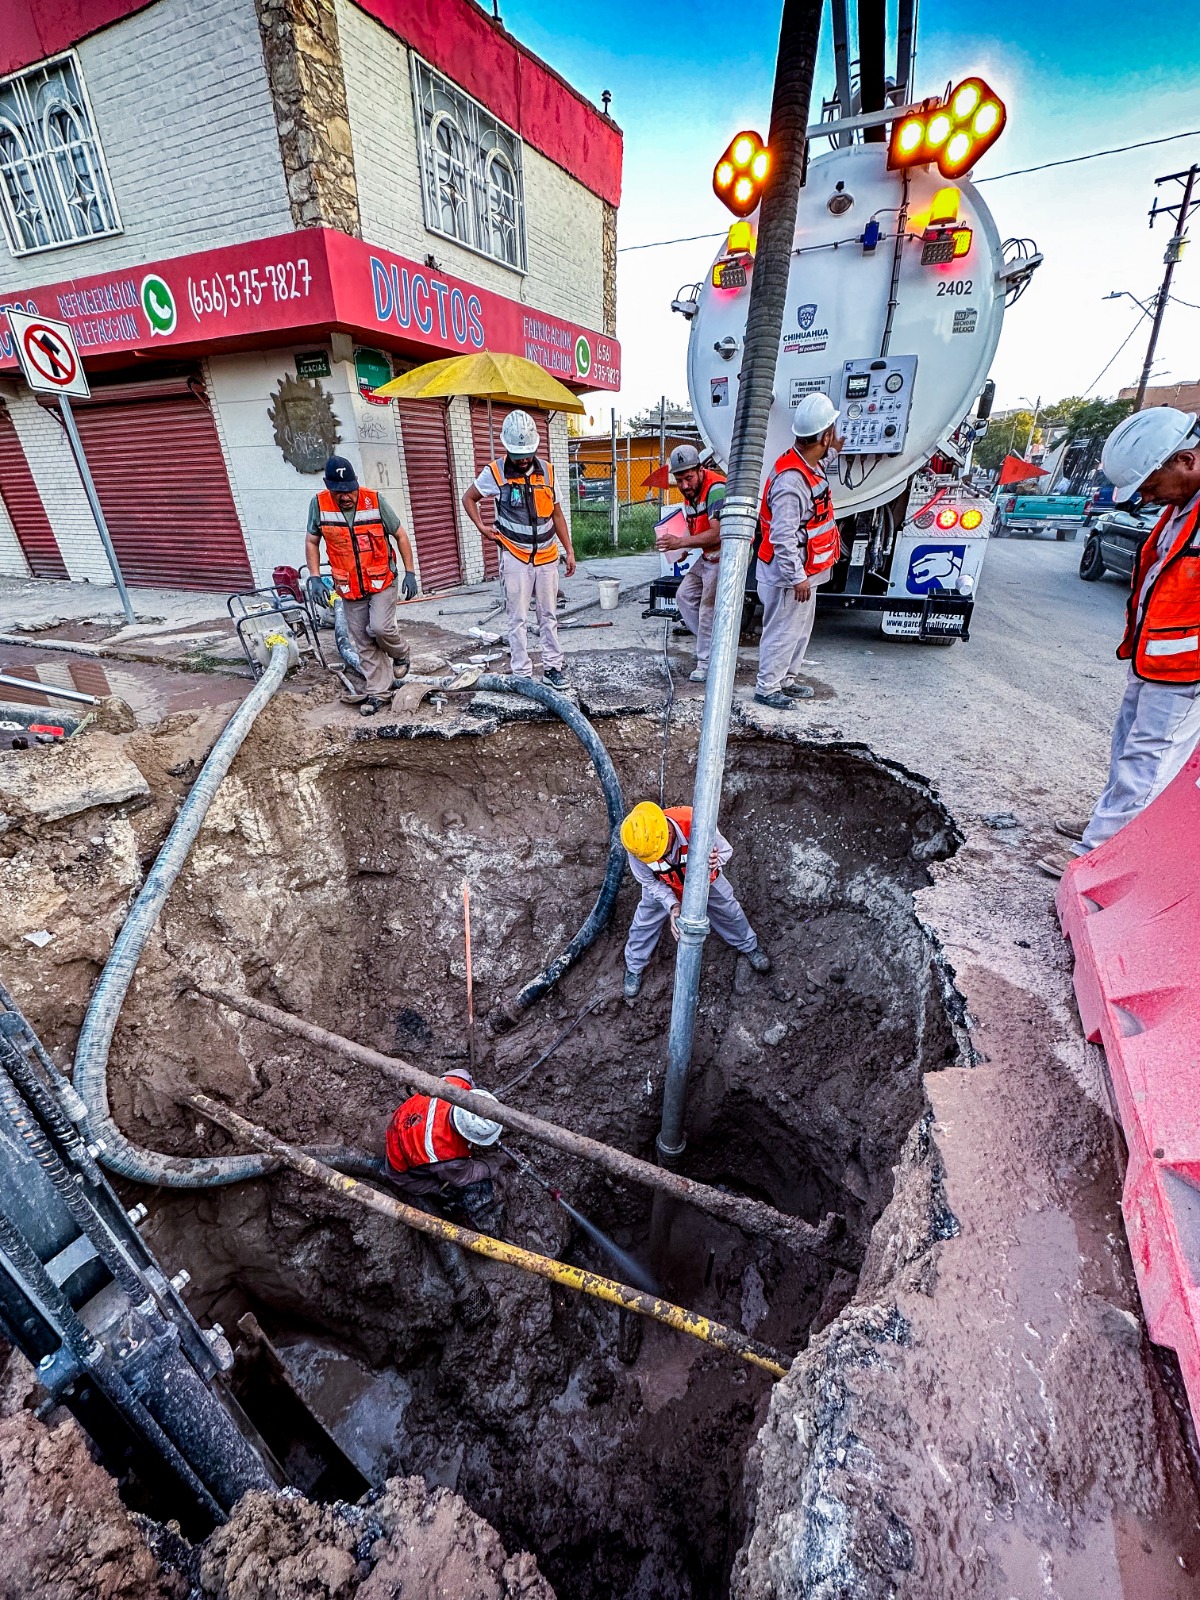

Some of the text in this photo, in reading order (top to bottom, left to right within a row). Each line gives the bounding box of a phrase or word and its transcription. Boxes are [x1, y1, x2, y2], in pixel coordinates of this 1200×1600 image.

[56, 279, 141, 319] REFRIGERACION
[936, 279, 973, 297] 2402
[369, 255, 485, 348] DUCTOS
[72, 312, 141, 347] ALEFACCION
[782, 328, 829, 342] CHIHUAHUA
[596, 338, 612, 365] (656)
[300, 363, 327, 374] ACACIAS
[593, 363, 620, 385] 375-7827
